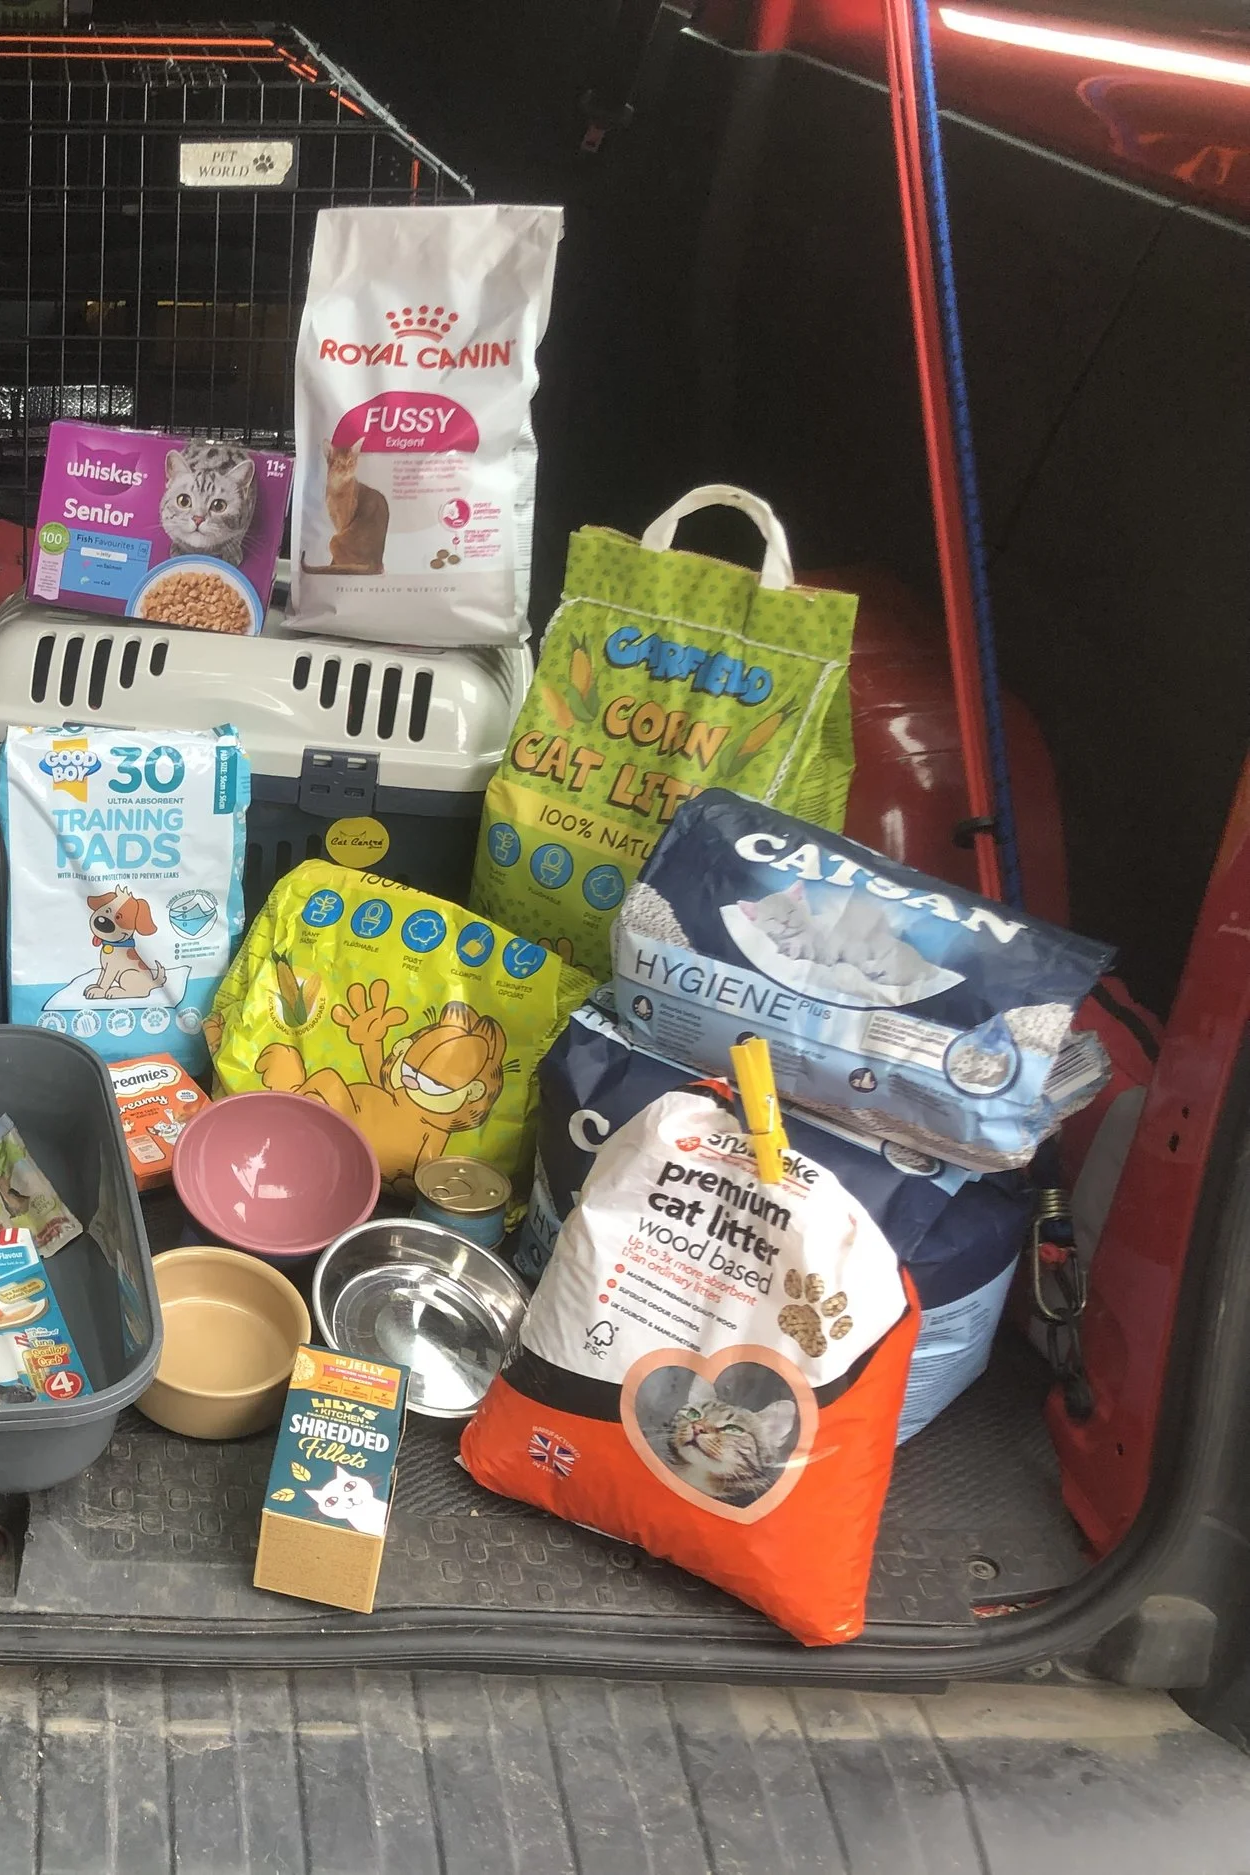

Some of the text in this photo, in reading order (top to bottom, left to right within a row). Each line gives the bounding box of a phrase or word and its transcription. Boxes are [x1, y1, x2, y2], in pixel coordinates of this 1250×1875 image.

[212, 151, 237, 162] PET
[199, 166, 249, 177] WORLD
[319, 338, 512, 370] ROYAL CANIN
[363, 407, 456, 434] FUSSY
[385, 436, 425, 448] Exigent
[67, 459, 143, 487] whiskas
[266, 459, 286, 471] 11+
[63, 498, 134, 527] Senior
[76, 534, 135, 550] Fish Favourites
[604, 695, 731, 772] CORN
[44, 750, 98, 767] GOOD
[52, 766, 90, 784] BOY
[108, 745, 185, 794] 30
[510, 730, 703, 824] CAT LIT
[52, 808, 183, 832] TRAINING
[331, 837, 347, 845] Cat
[539, 805, 656, 861] 100% NATU
[56, 833, 181, 871] PADS
[102, 873, 131, 881] PROTECTION
[734, 832, 1028, 944] CATSAN
[343, 940, 379, 953] FLUSHABLE
[402, 964, 420, 973] FREE
[403, 956, 423, 964] DUST
[635, 949, 832, 1022] HYGIENE Plus
[112, 1069, 169, 1090] reamies
[119, 1096, 168, 1114] reamy
[656, 1160, 791, 1231] premium
[648, 1192, 780, 1266] cat litter
[0, 1251, 23, 1260] Flavour
[639, 1217, 773, 1295] wood based
[622, 1247, 721, 1304] than ordinary litters
[628, 1234, 758, 1306] Up to 3x more absorbent
[626, 1270, 737, 1330] MADE FROM PREMIUM QUALITY WOOD
[610, 1301, 620, 1310] UK
[620, 1307, 647, 1325] SOURCED
[672, 1314, 701, 1332] CONTROL
[33, 1346, 67, 1357] Scallop
[39, 1355, 62, 1366] Crab
[583, 1341, 608, 1360] FSC
[336, 1358, 385, 1376] IN JELLY
[51, 1371, 74, 1392] 4
[311, 1398, 379, 1420] LILY'S
[320, 1408, 364, 1423] KITCHEN
[289, 1414, 389, 1452] SHREDDED
[298, 1437, 368, 1468] Fillets
